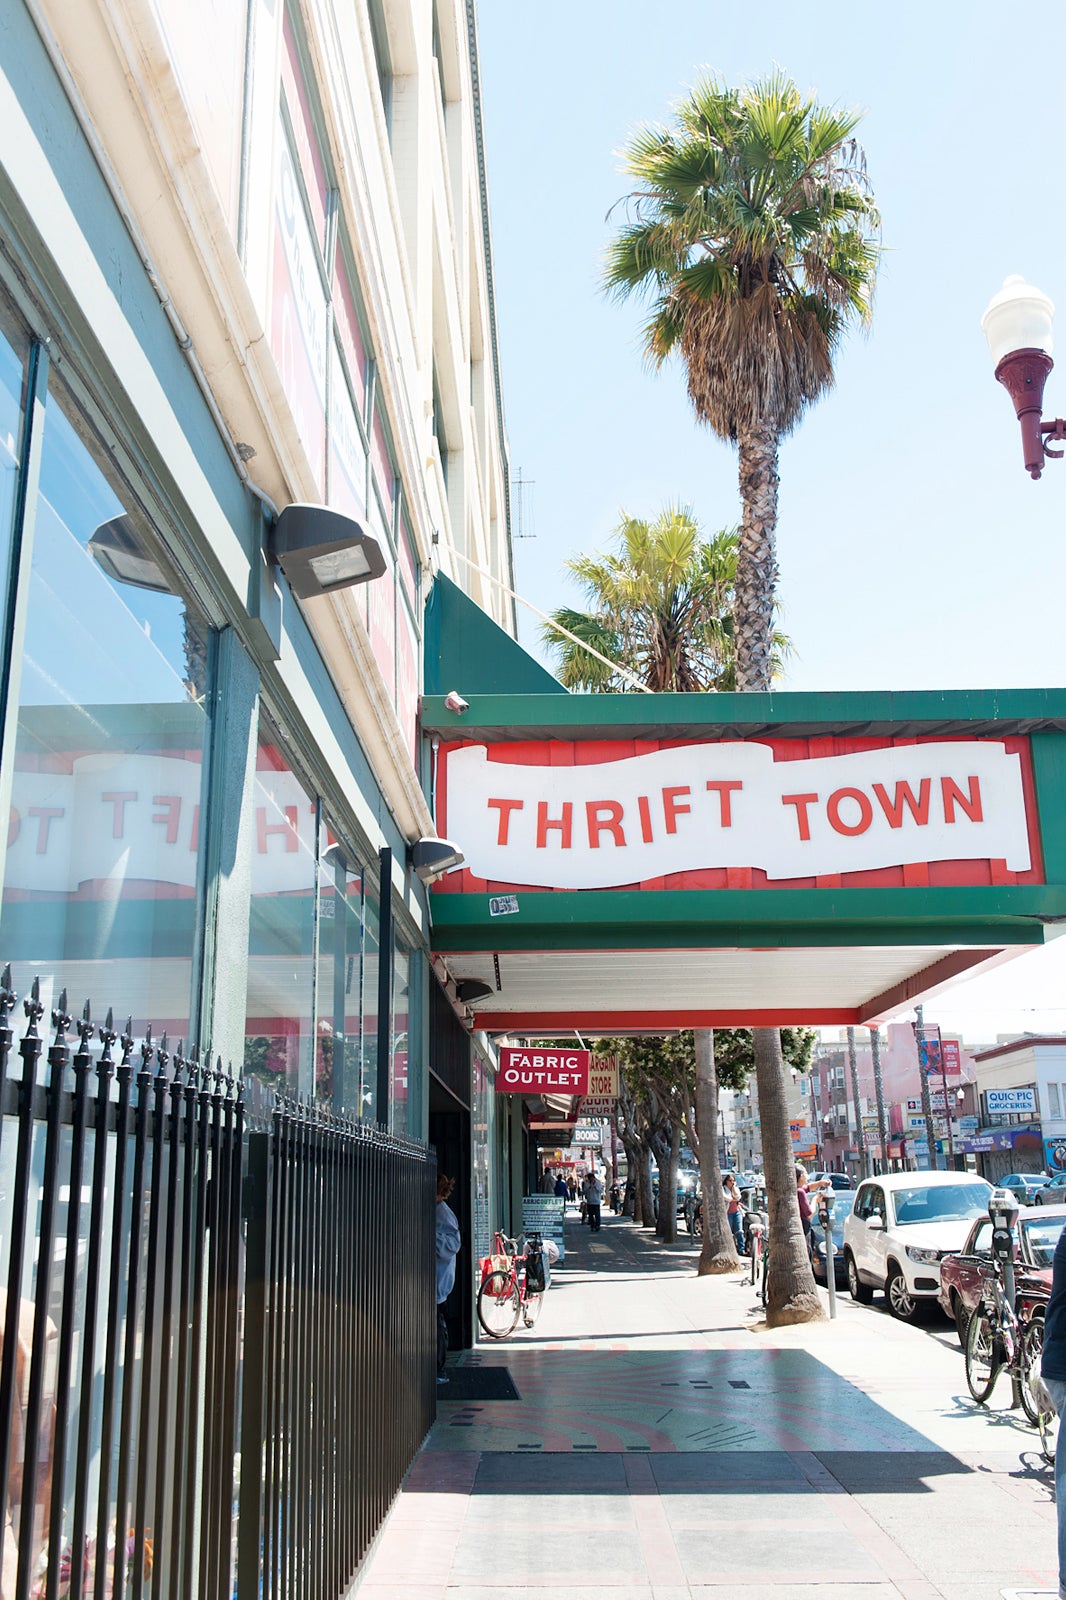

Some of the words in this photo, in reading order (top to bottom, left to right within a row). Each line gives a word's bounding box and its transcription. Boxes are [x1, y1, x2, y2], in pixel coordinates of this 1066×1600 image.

[487, 780, 743, 849] THRIFT
[782, 775, 984, 841] TOWN
[509, 1053, 578, 1068] FABRIC
[590, 1054, 616, 1072] ARGAIN
[504, 1070, 582, 1085] OUTLET
[591, 1076, 612, 1094] STORE
[989, 1092, 1014, 1101] QUIC
[1016, 1091, 1032, 1100] PIC
[575, 1130, 599, 1141] BOOKS
